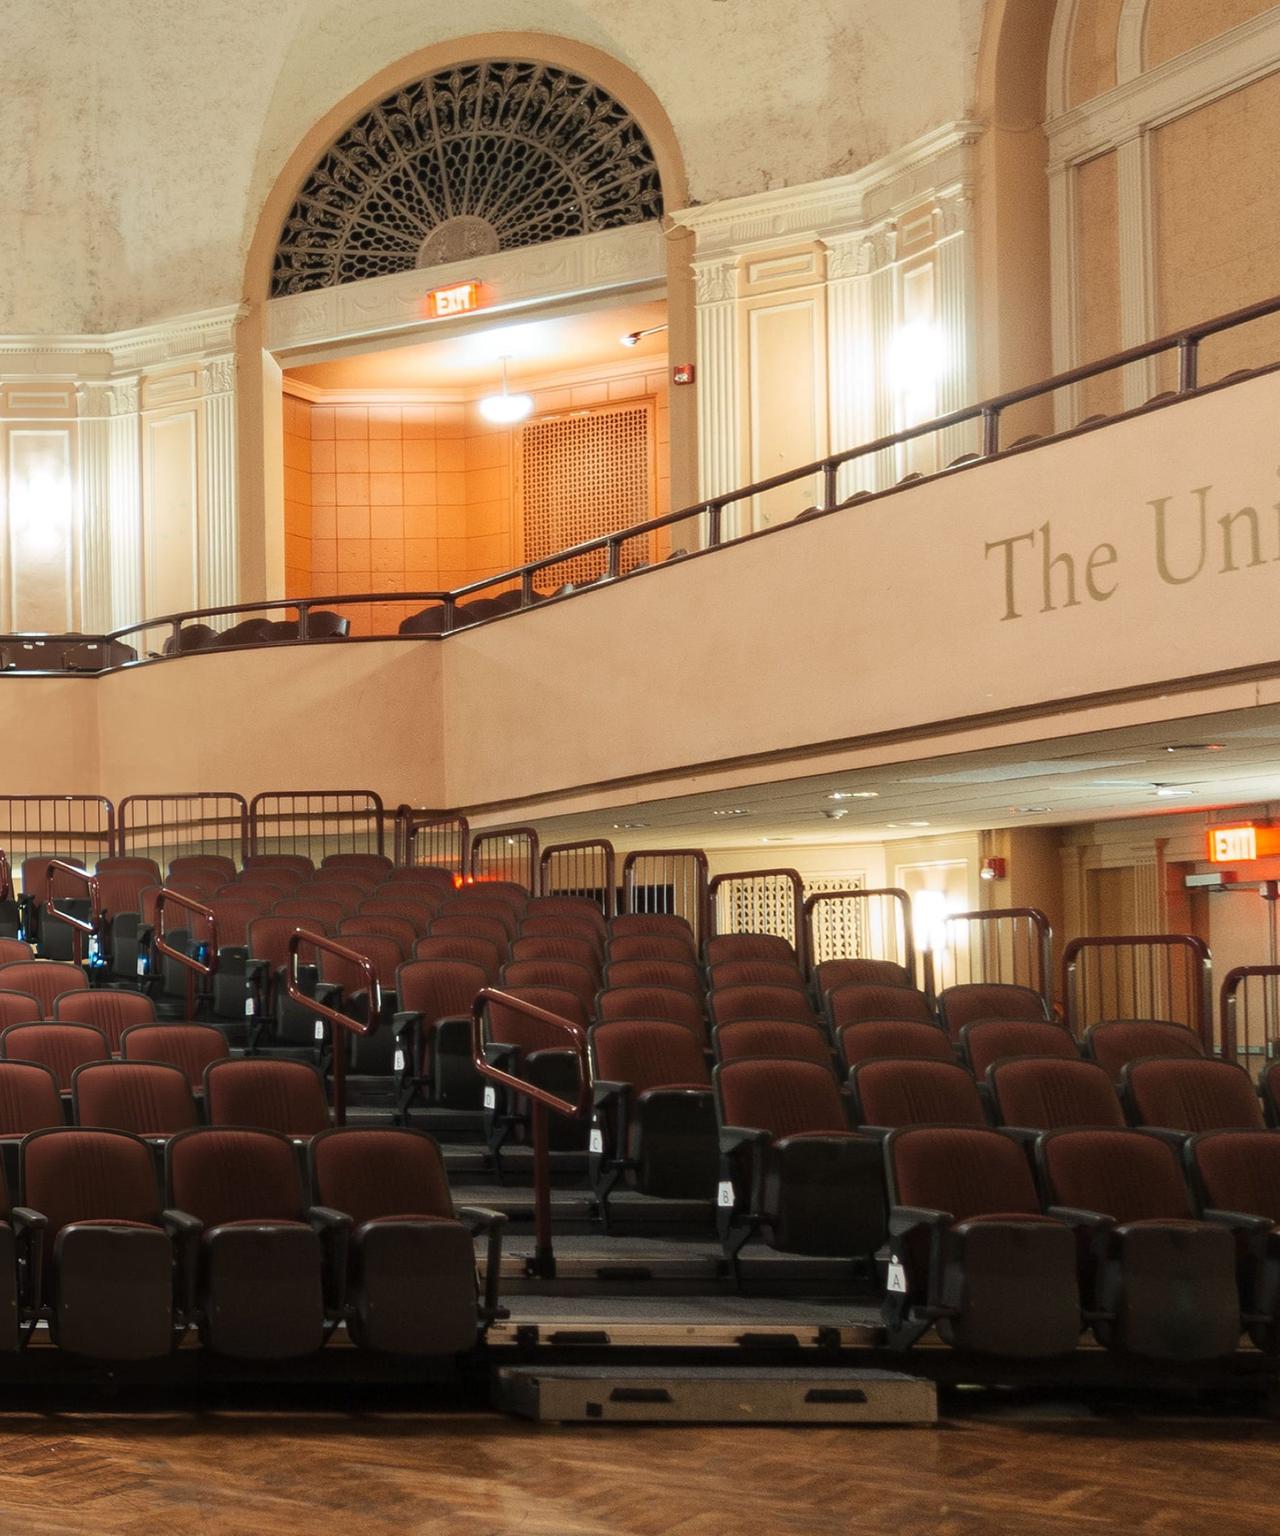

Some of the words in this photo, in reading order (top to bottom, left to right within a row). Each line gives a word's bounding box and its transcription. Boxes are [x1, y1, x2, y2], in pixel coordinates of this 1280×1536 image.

[435, 284, 471, 315] EXIT
[985, 520, 1119, 621] The
[1215, 828, 1256, 861] EXIT
[593, 1137, 598, 1150] C
[723, 1190, 729, 1204] B
[892, 1274, 901, 1289] A
